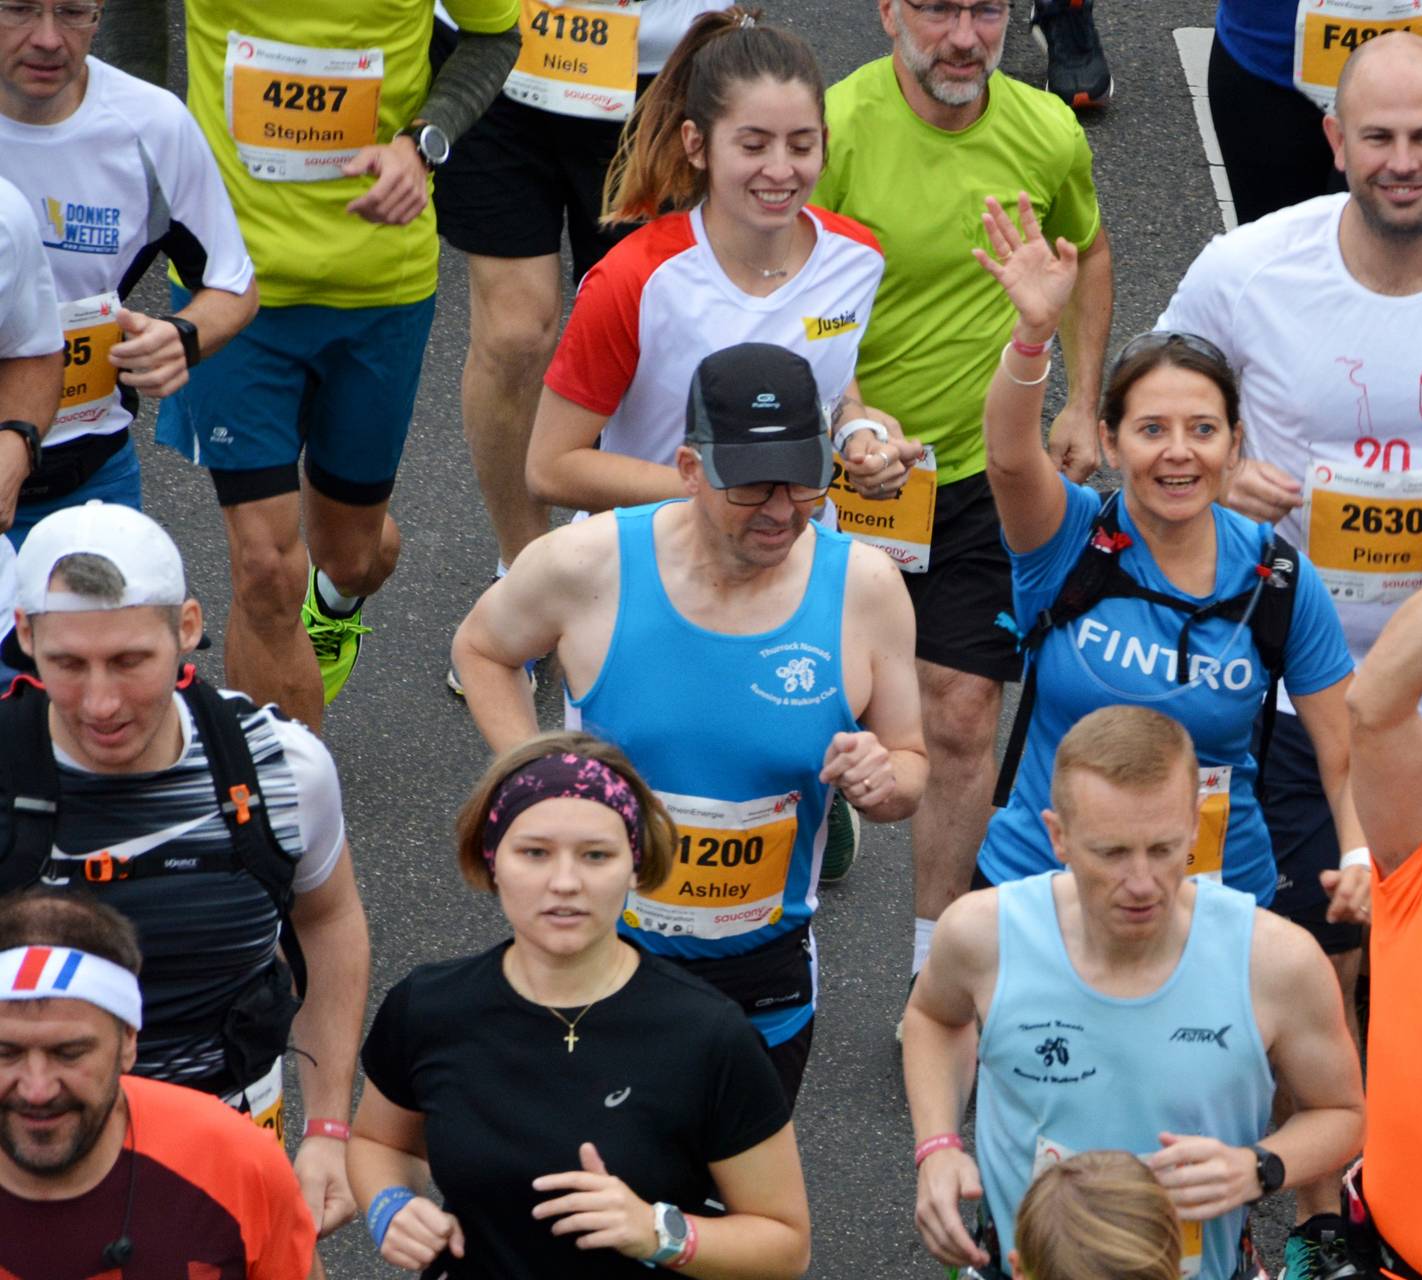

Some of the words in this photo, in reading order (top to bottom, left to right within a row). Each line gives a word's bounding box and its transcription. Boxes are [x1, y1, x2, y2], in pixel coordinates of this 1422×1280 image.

[531, 9, 609, 46] 4188
[543, 53, 589, 74] Niels
[263, 80, 348, 112] 4287
[264, 122, 344, 143] Stephan
[66, 203, 120, 227] DONNER
[65, 222, 120, 246] WETTER
[836, 504, 896, 529] incent
[1353, 547, 1412, 564] Pierre
[1076, 617, 1253, 692] FINTRO
[680, 835, 764, 868] 1200
[678, 880, 751, 900] Ashley
[714, 905, 766, 924] saucony
